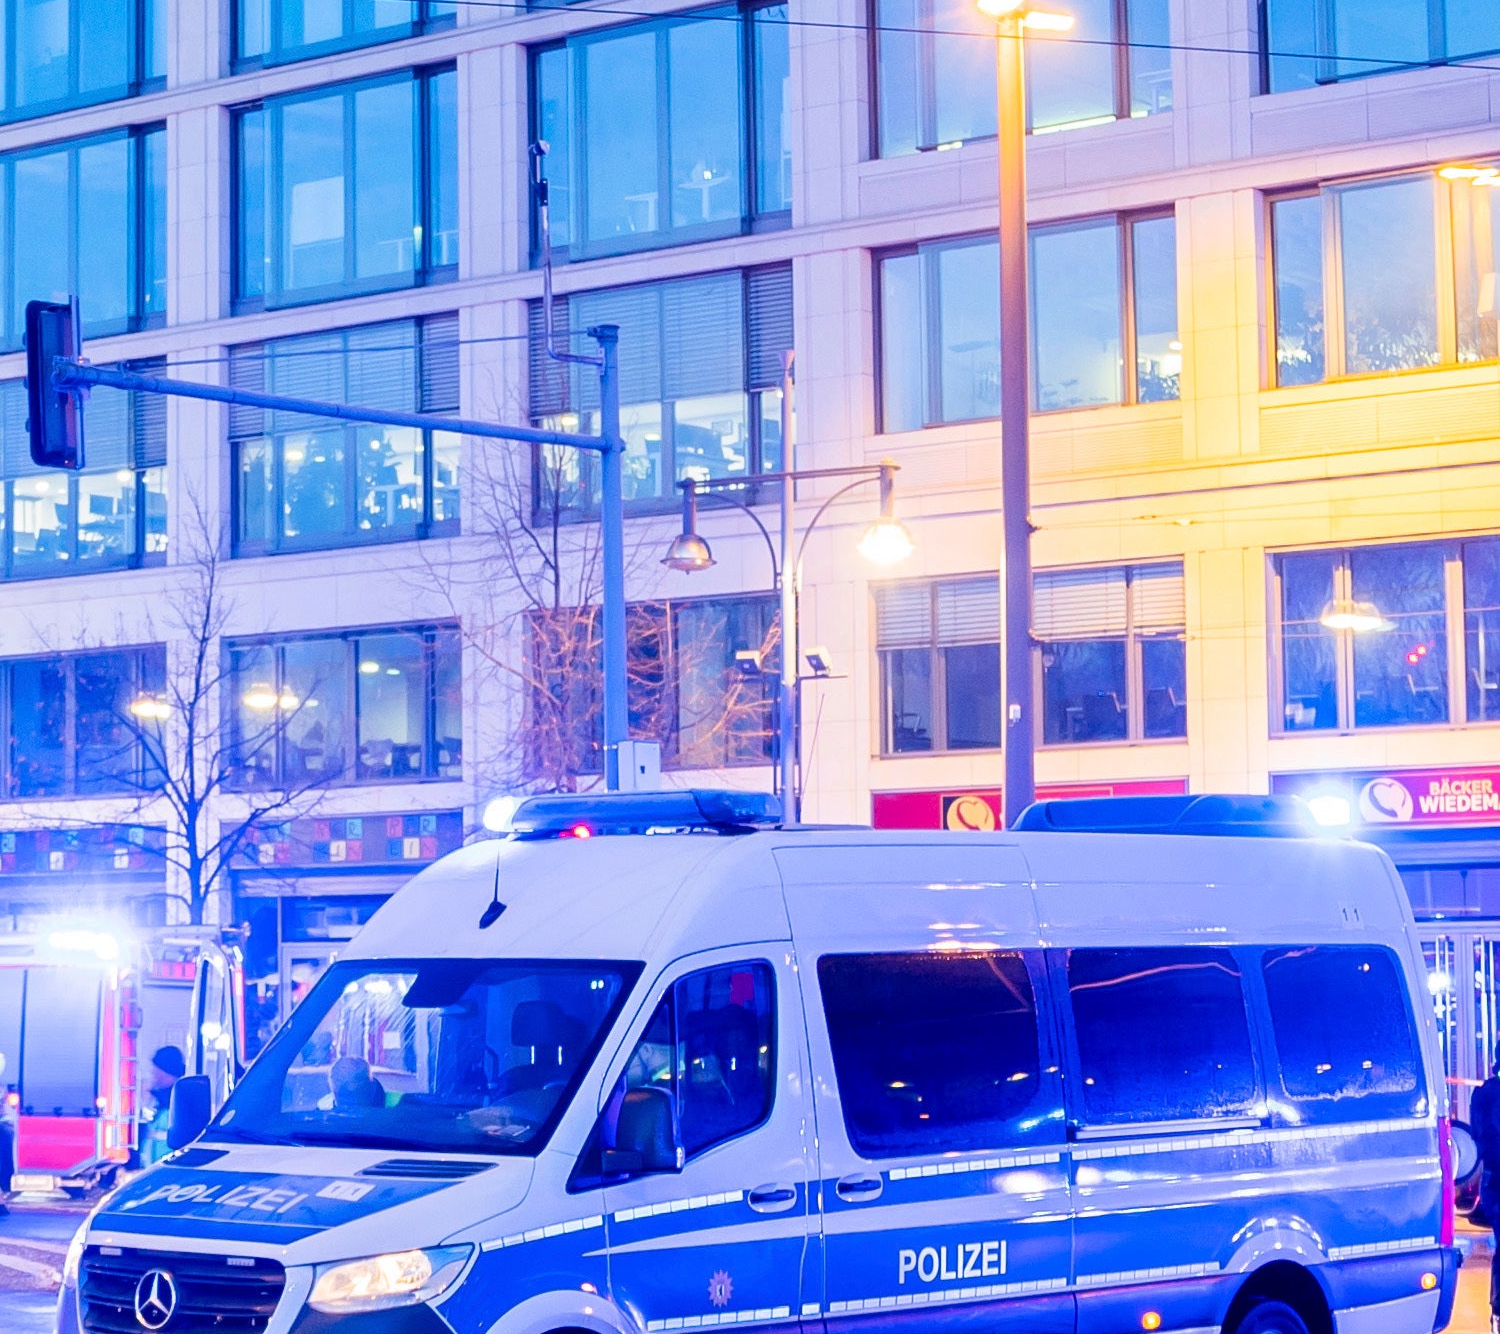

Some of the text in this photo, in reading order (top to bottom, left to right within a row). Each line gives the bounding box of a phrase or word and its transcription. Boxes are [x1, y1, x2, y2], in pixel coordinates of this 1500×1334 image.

[1429, 778, 1493, 795] BÄCKER
[1342, 908, 1359, 922] 11
[144, 1184, 309, 1214] POLIZEI
[898, 1239, 1008, 1285] POLIZEI
